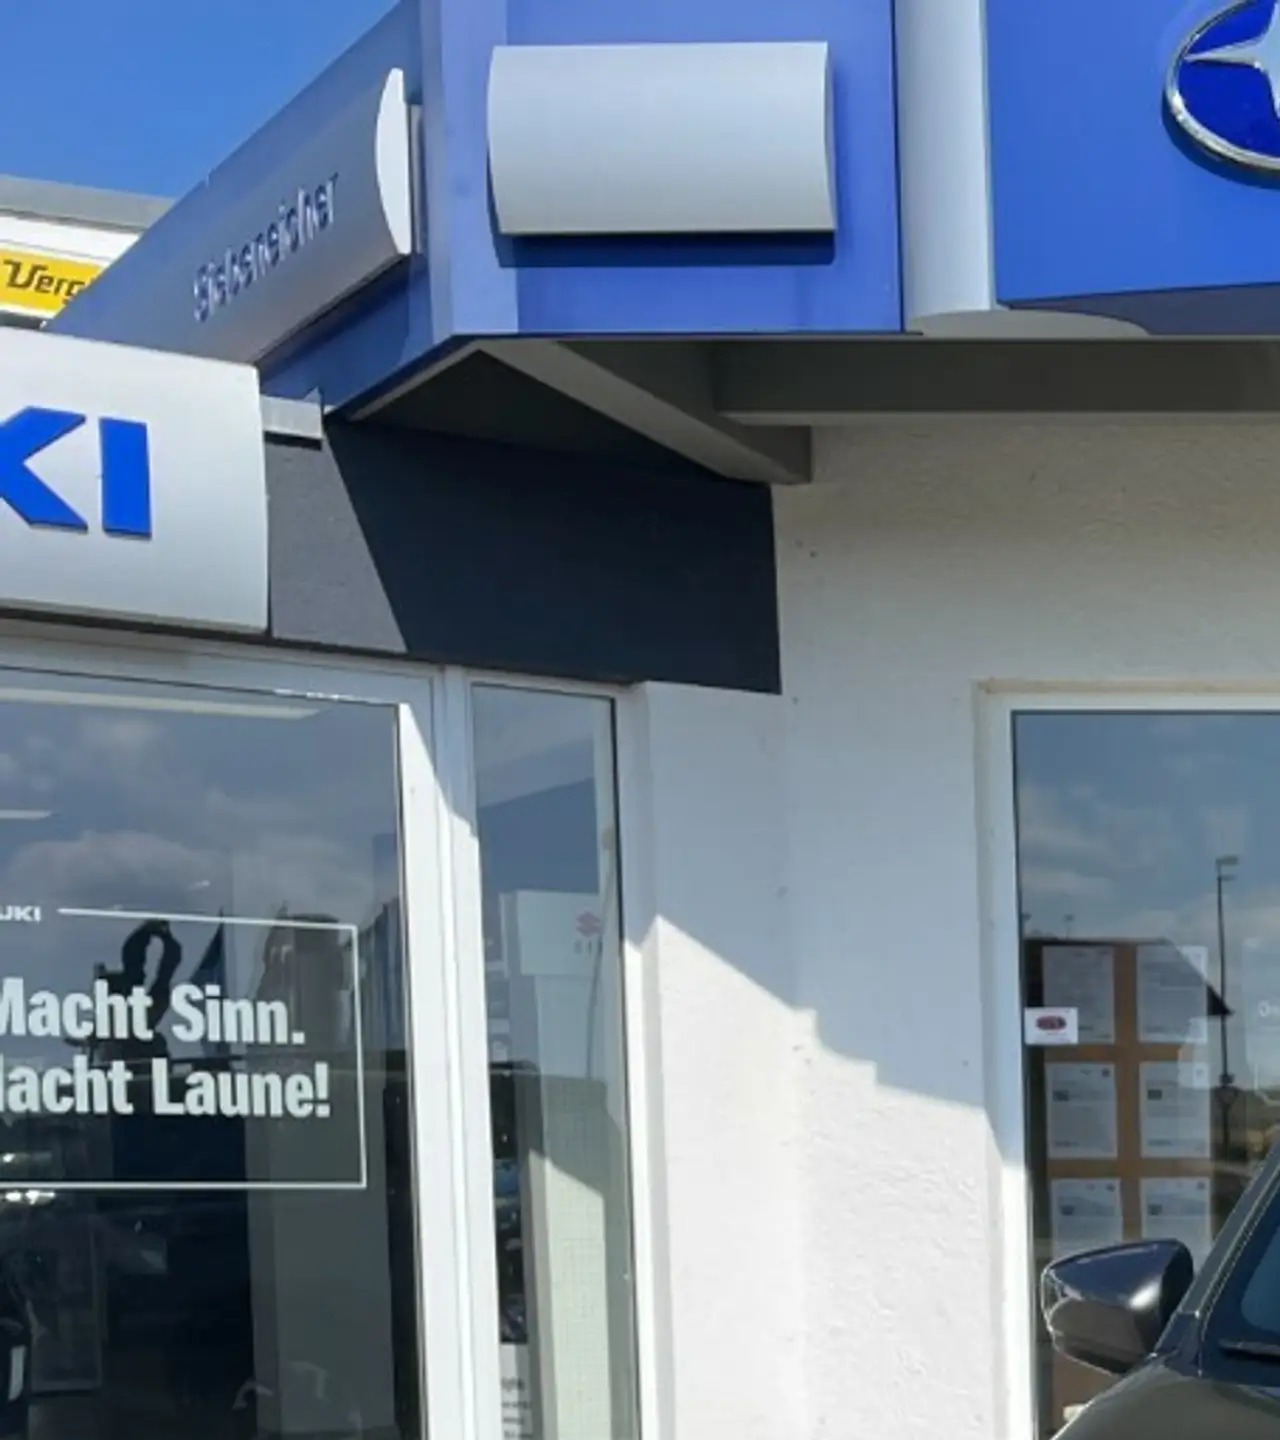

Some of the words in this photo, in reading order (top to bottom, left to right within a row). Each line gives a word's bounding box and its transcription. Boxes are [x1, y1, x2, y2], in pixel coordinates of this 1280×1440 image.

[171, 983, 305, 1044] Sinn.
[0, 1055, 134, 1115] acht
[152, 1058, 331, 1118] Laune!
